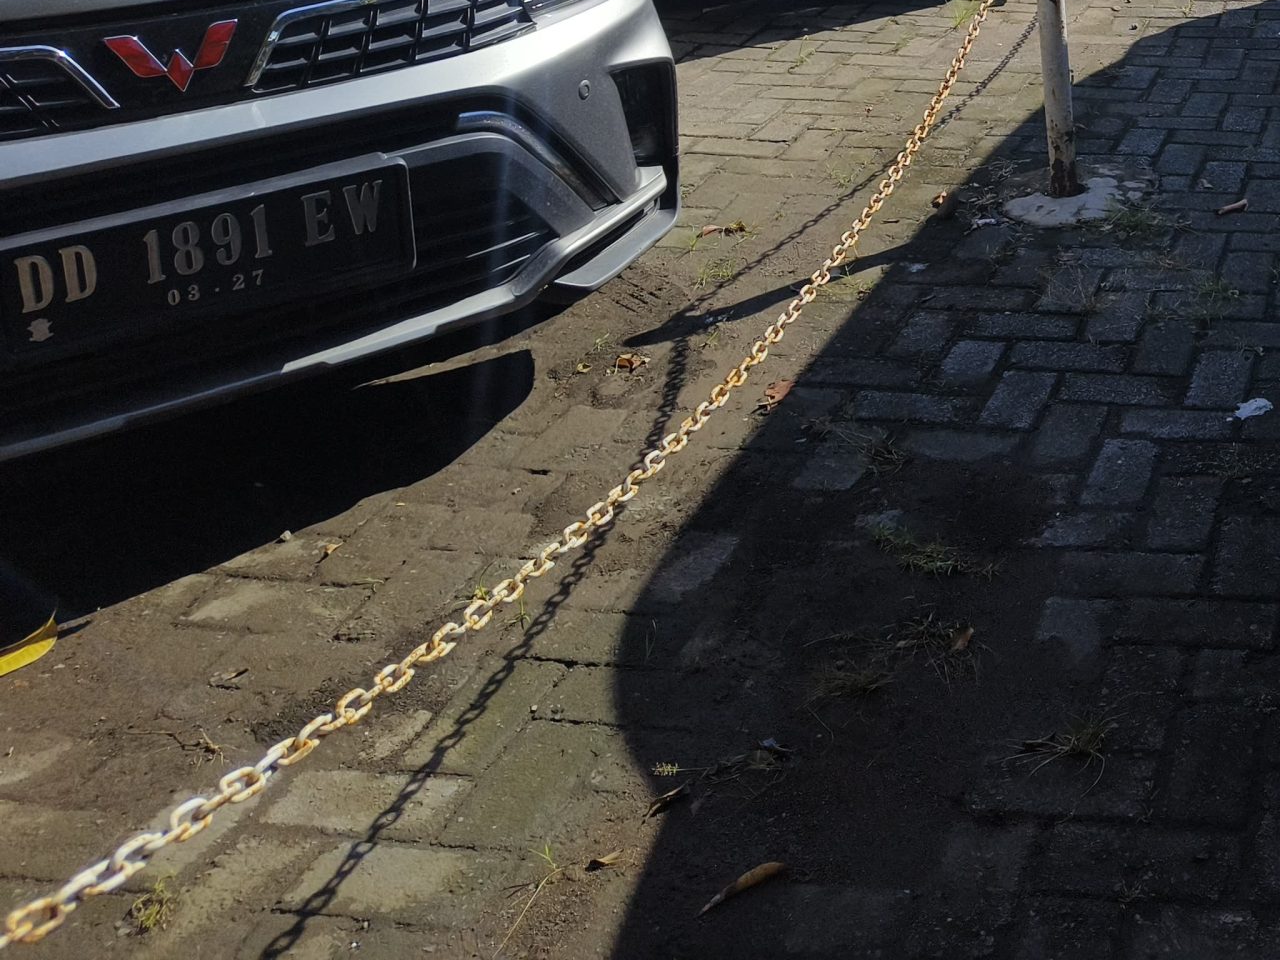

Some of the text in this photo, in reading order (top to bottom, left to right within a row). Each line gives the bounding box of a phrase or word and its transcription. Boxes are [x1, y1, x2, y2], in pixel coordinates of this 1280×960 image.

[14, 178, 384, 315] DD 1891 EW
